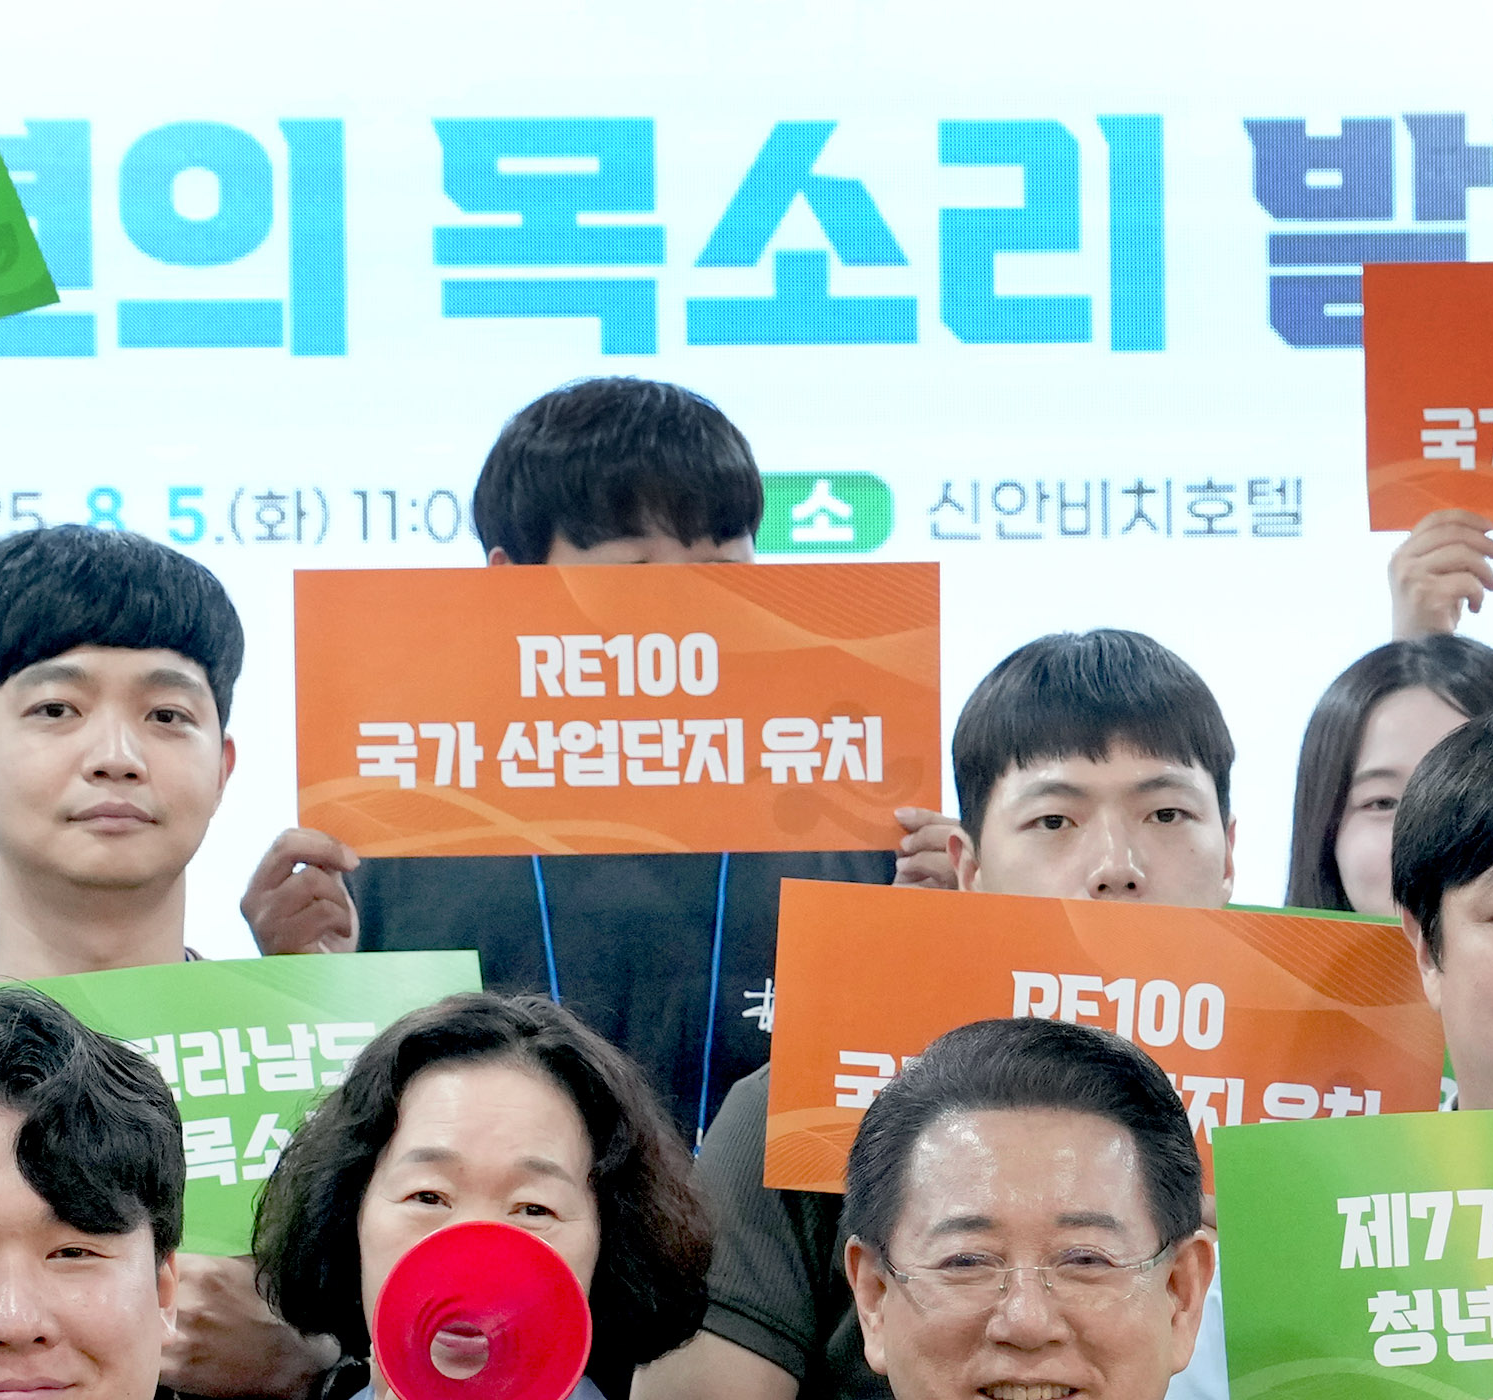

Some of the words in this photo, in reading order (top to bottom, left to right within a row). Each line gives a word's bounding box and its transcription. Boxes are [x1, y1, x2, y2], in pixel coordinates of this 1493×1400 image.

[431, 114, 1166, 355] 목소리
[353, 489, 484, 545] 11:0
[928, 477, 1302, 540] 신안비치호텔
[517, 632, 719, 697] RE100
[356, 720, 482, 789] 국가
[497, 718, 744, 786] 산업단지
[760, 716, 883, 783] 유치
[1011, 970, 1226, 1050] RE100
[182, 1111, 316, 1186] 목소
